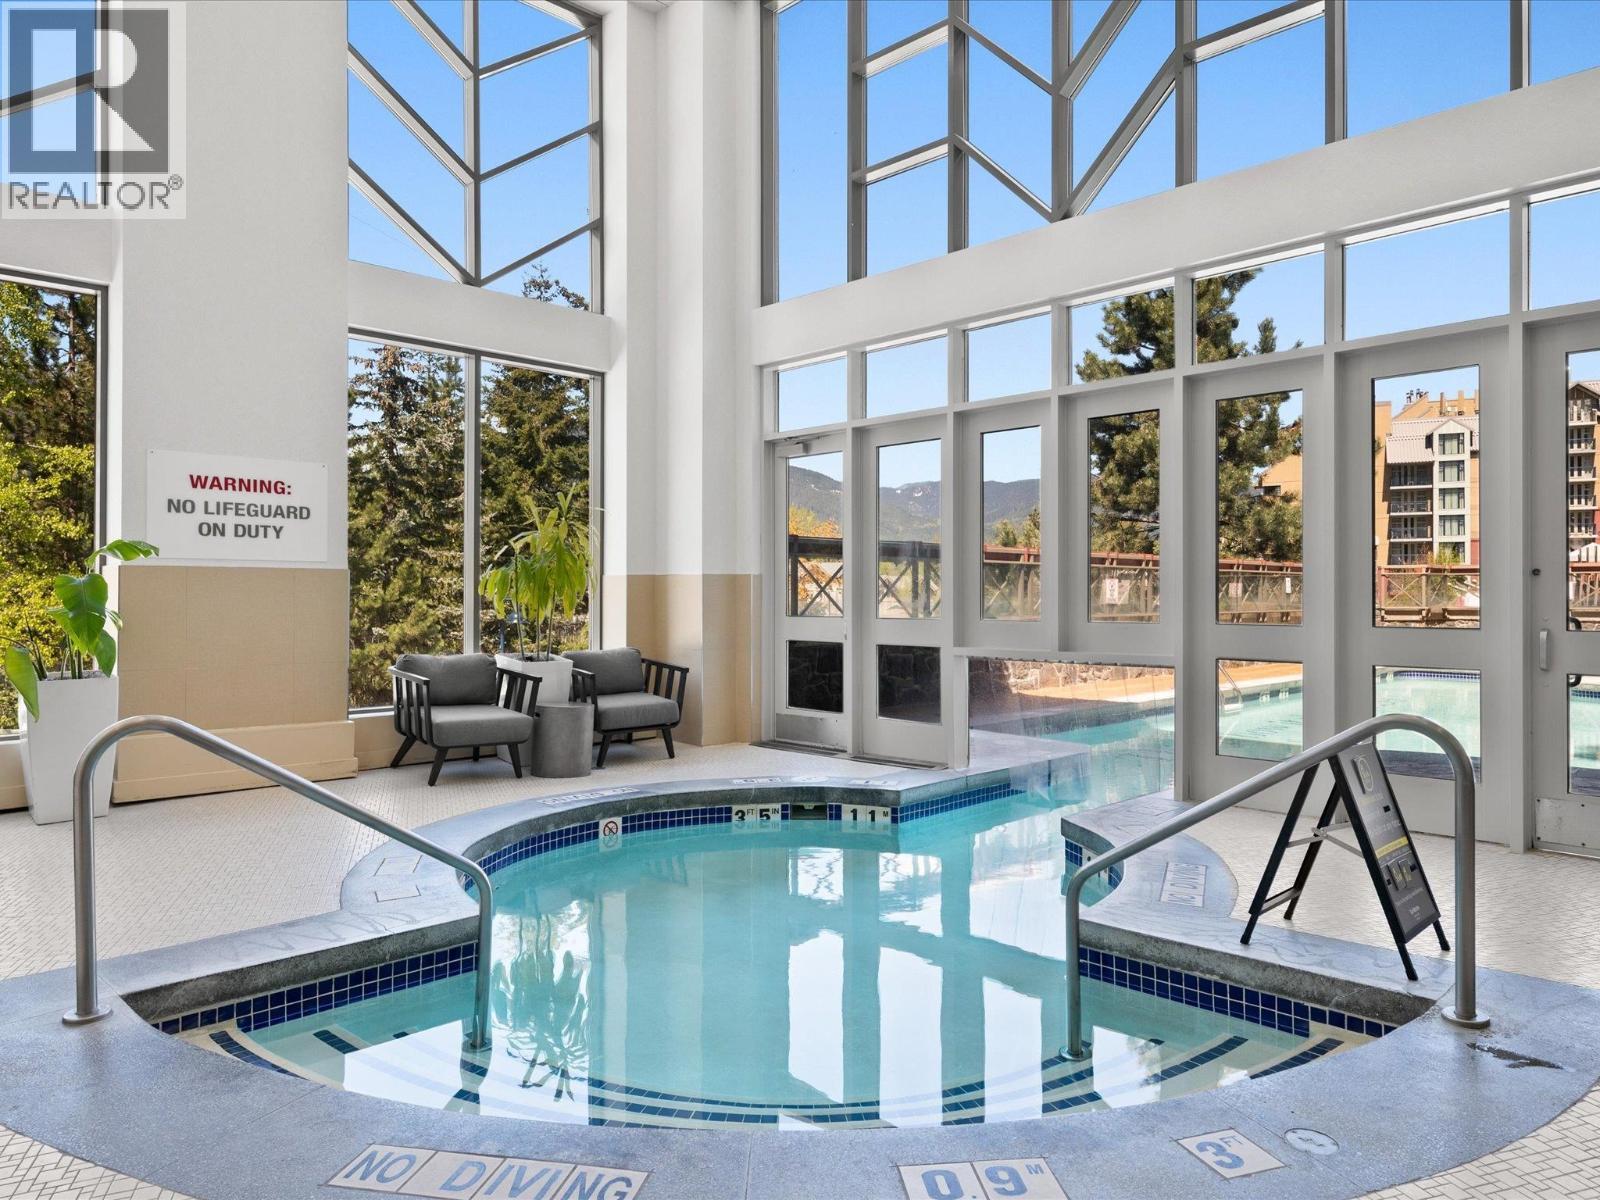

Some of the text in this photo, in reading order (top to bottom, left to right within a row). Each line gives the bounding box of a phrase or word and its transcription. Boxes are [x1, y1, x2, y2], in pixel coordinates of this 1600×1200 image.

[189, 474, 292, 496] WARNING:
[167, 498, 311, 520] NO LIFEGUARD
[198, 522, 284, 539] ON DUTY
[344, 1150, 633, 1200] NO DIVING
